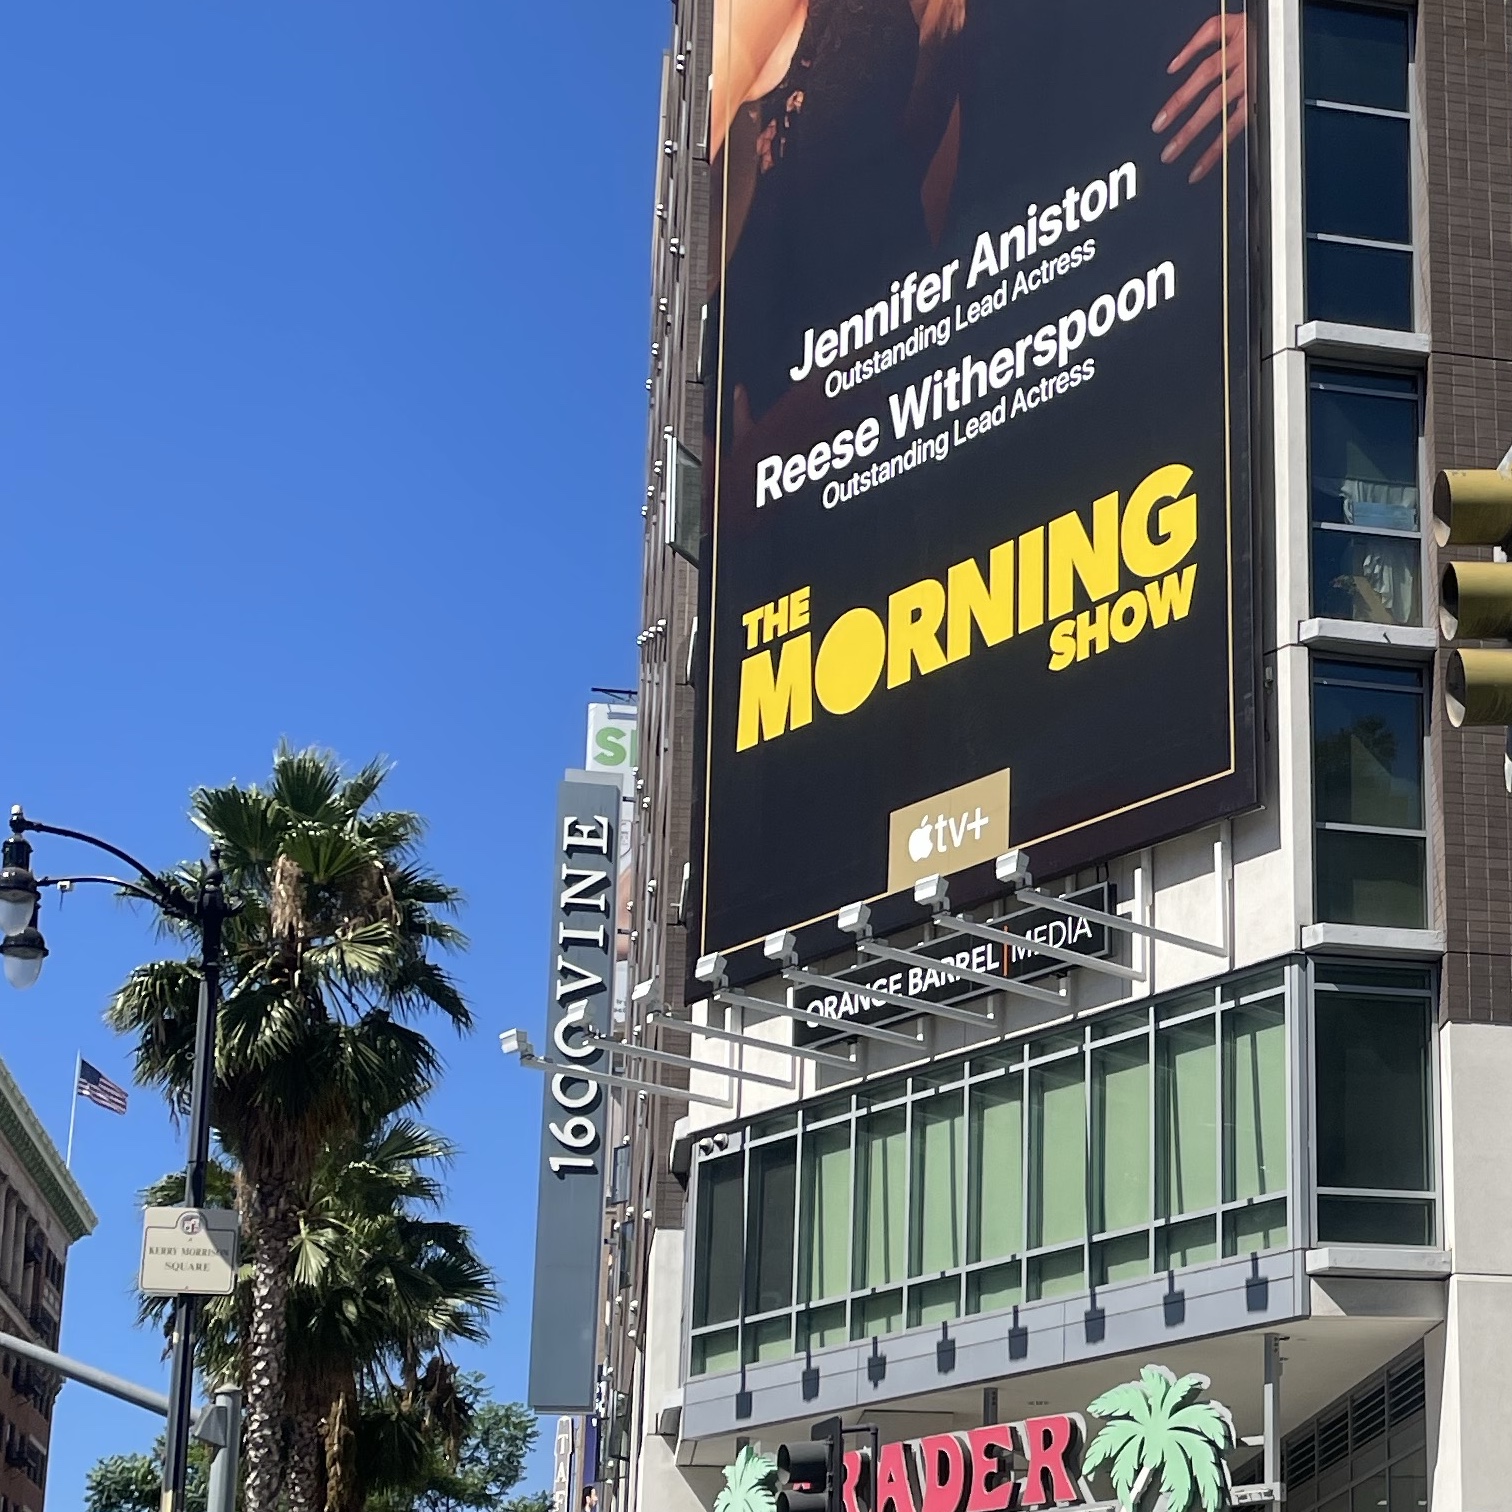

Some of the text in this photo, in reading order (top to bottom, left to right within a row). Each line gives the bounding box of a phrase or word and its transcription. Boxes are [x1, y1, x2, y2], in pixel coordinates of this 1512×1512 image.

[789, 161, 1137, 382] Jennifer Aniston
[824, 238, 1096, 398] Outstanding Lead Actress
[755, 260, 1175, 508] Reese Witherspoon
[822, 357, 1096, 510] Outstanding Lead Actress
[735, 463, 1198, 753] MORNING
[741, 585, 811, 651] THE
[1047, 563, 1198, 672] SHOW
[548, 815, 610, 1176] 1600 VINE
[806, 915, 1093, 1028] ORANGE BARREL MEDIA
[148, 1246, 177, 1256] KERRY
[164, 1262, 211, 1272] SQUARE
